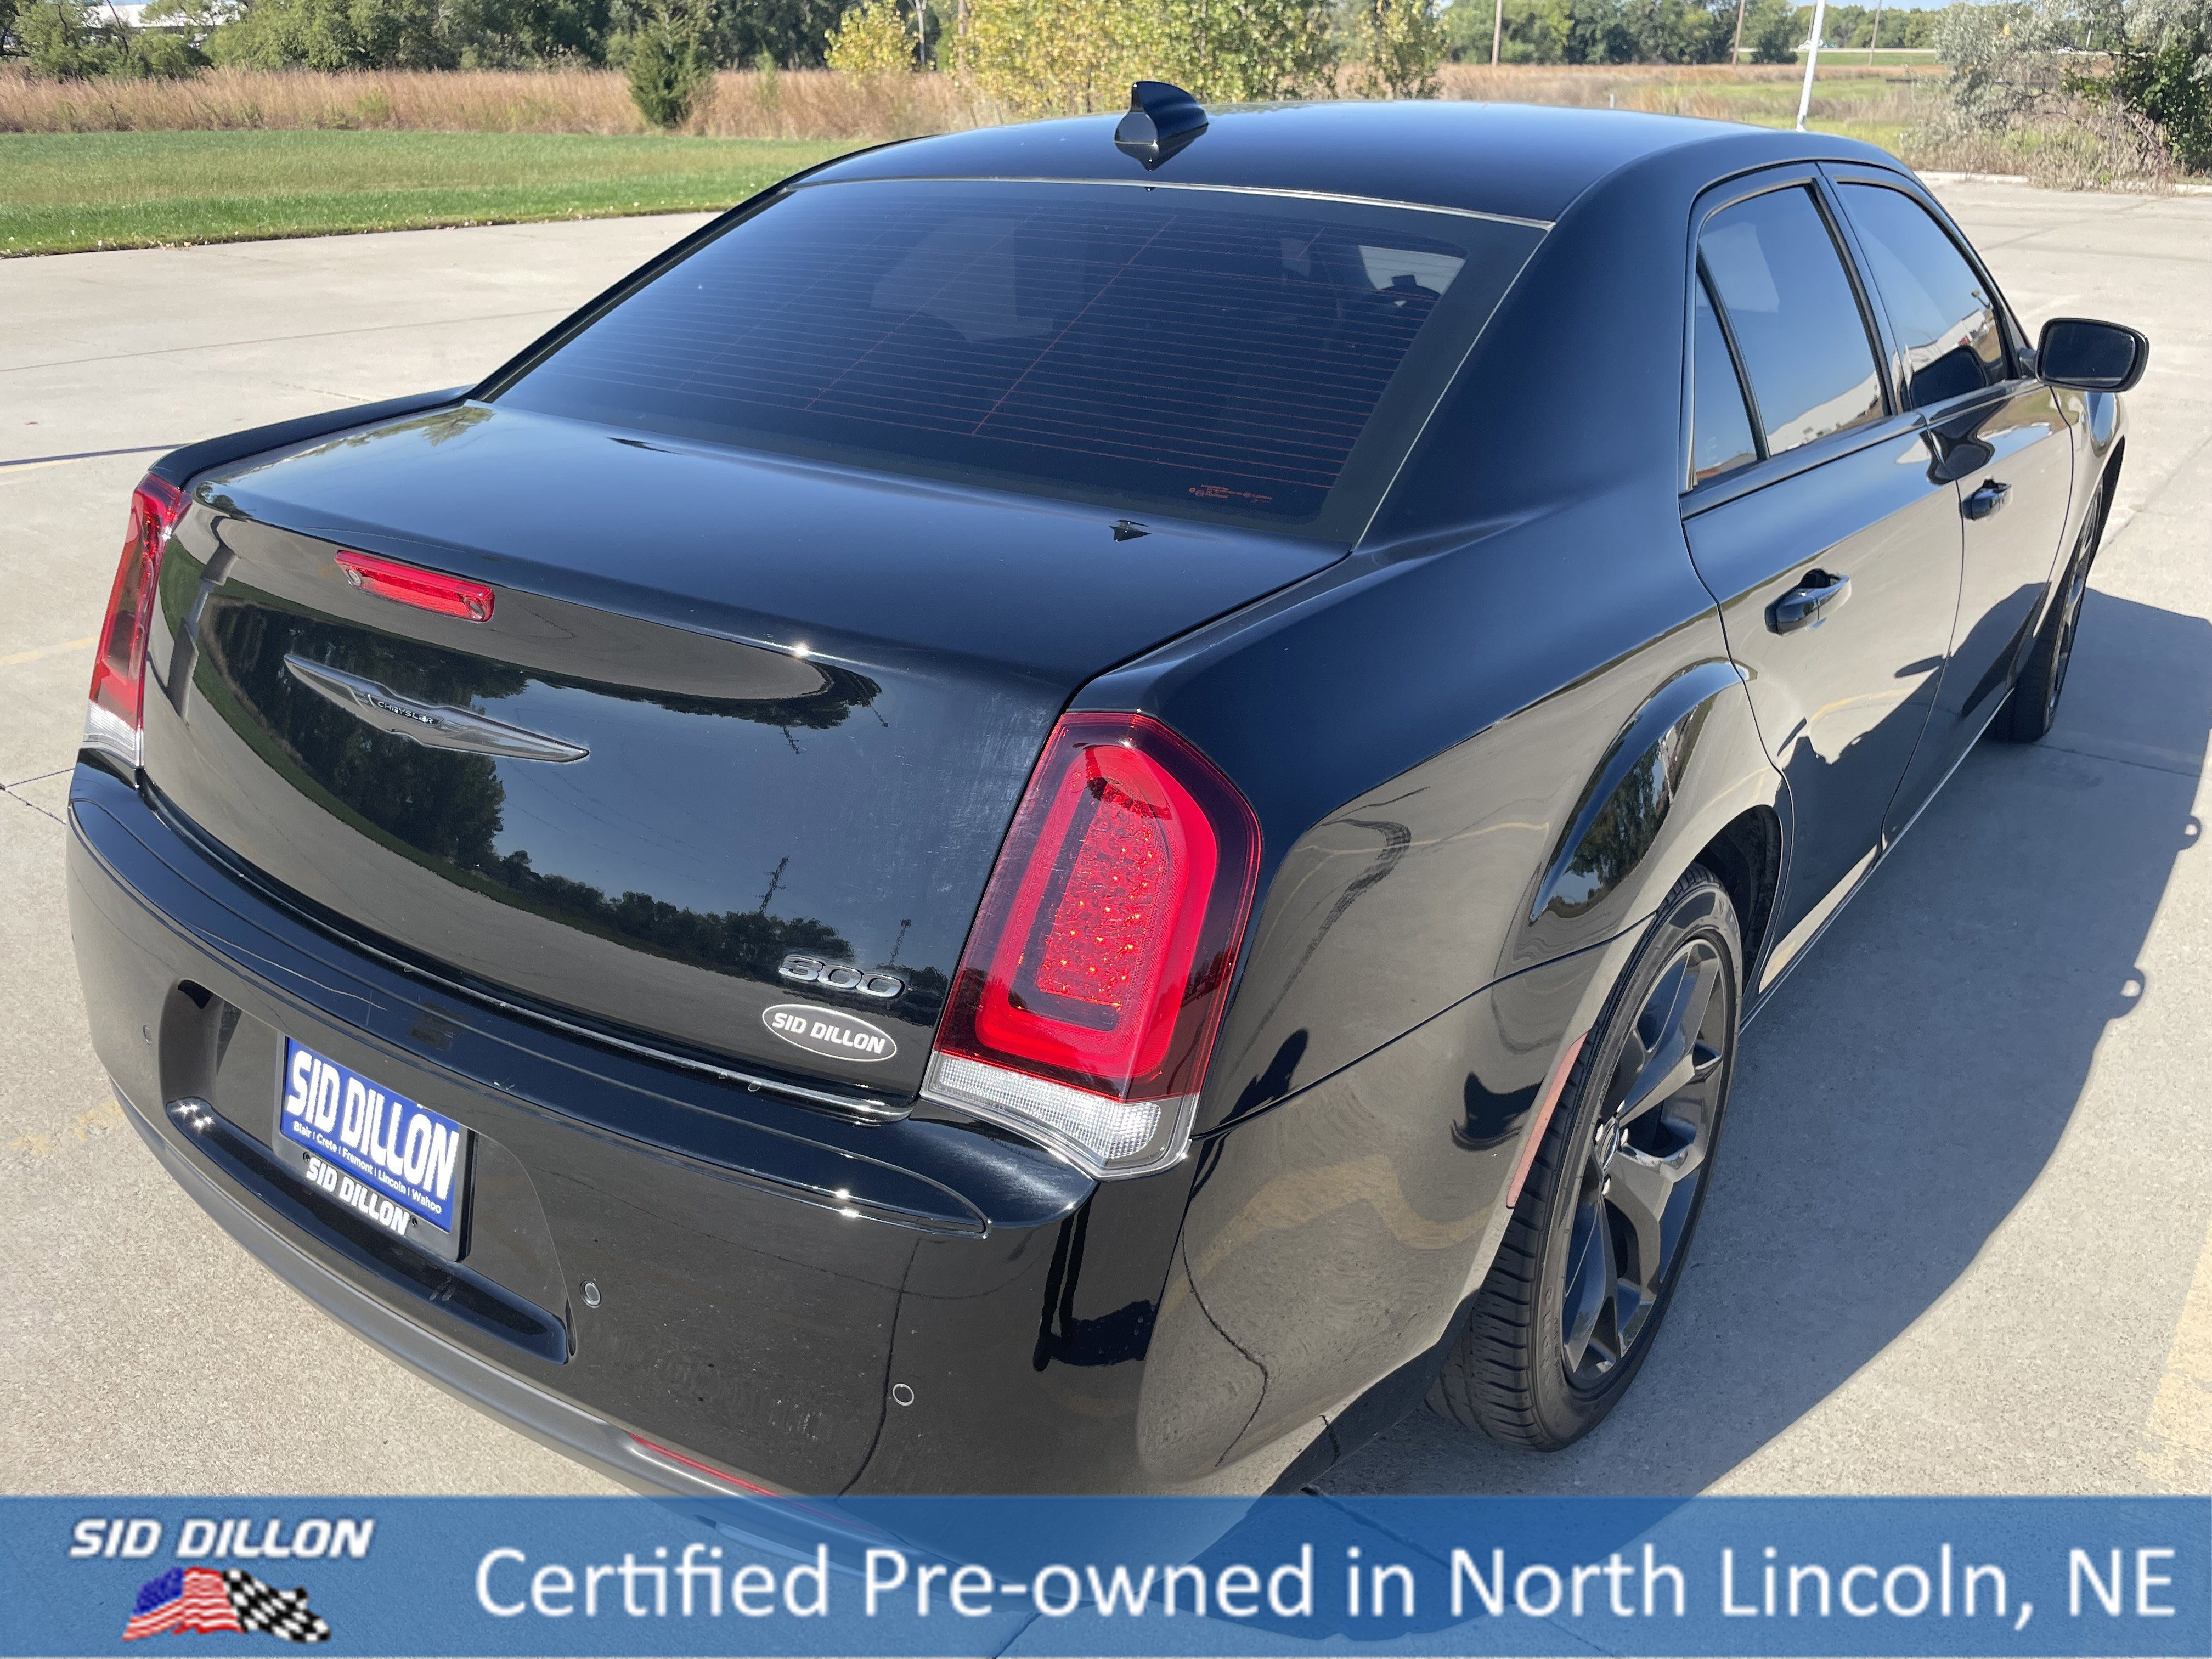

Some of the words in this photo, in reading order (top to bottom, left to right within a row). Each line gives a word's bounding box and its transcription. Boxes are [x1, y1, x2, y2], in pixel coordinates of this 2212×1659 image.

[377, 701, 434, 724] CHRYSLER
[778, 953, 906, 998] 300
[771, 1012, 808, 1034] SID
[809, 1022, 887, 1054] DILLON
[286, 1049, 341, 1134] SID
[340, 1076, 460, 1201] DILLON
[292, 1120, 312, 1138] Blair
[316, 1133, 338, 1153] Crete
[342, 1147, 374, 1175] Fremont
[377, 1169, 407, 1195] Lincoln
[411, 1188, 442, 1214] Wahoo
[305, 1156, 339, 1193] SID
[338, 1175, 411, 1237] DILLON
